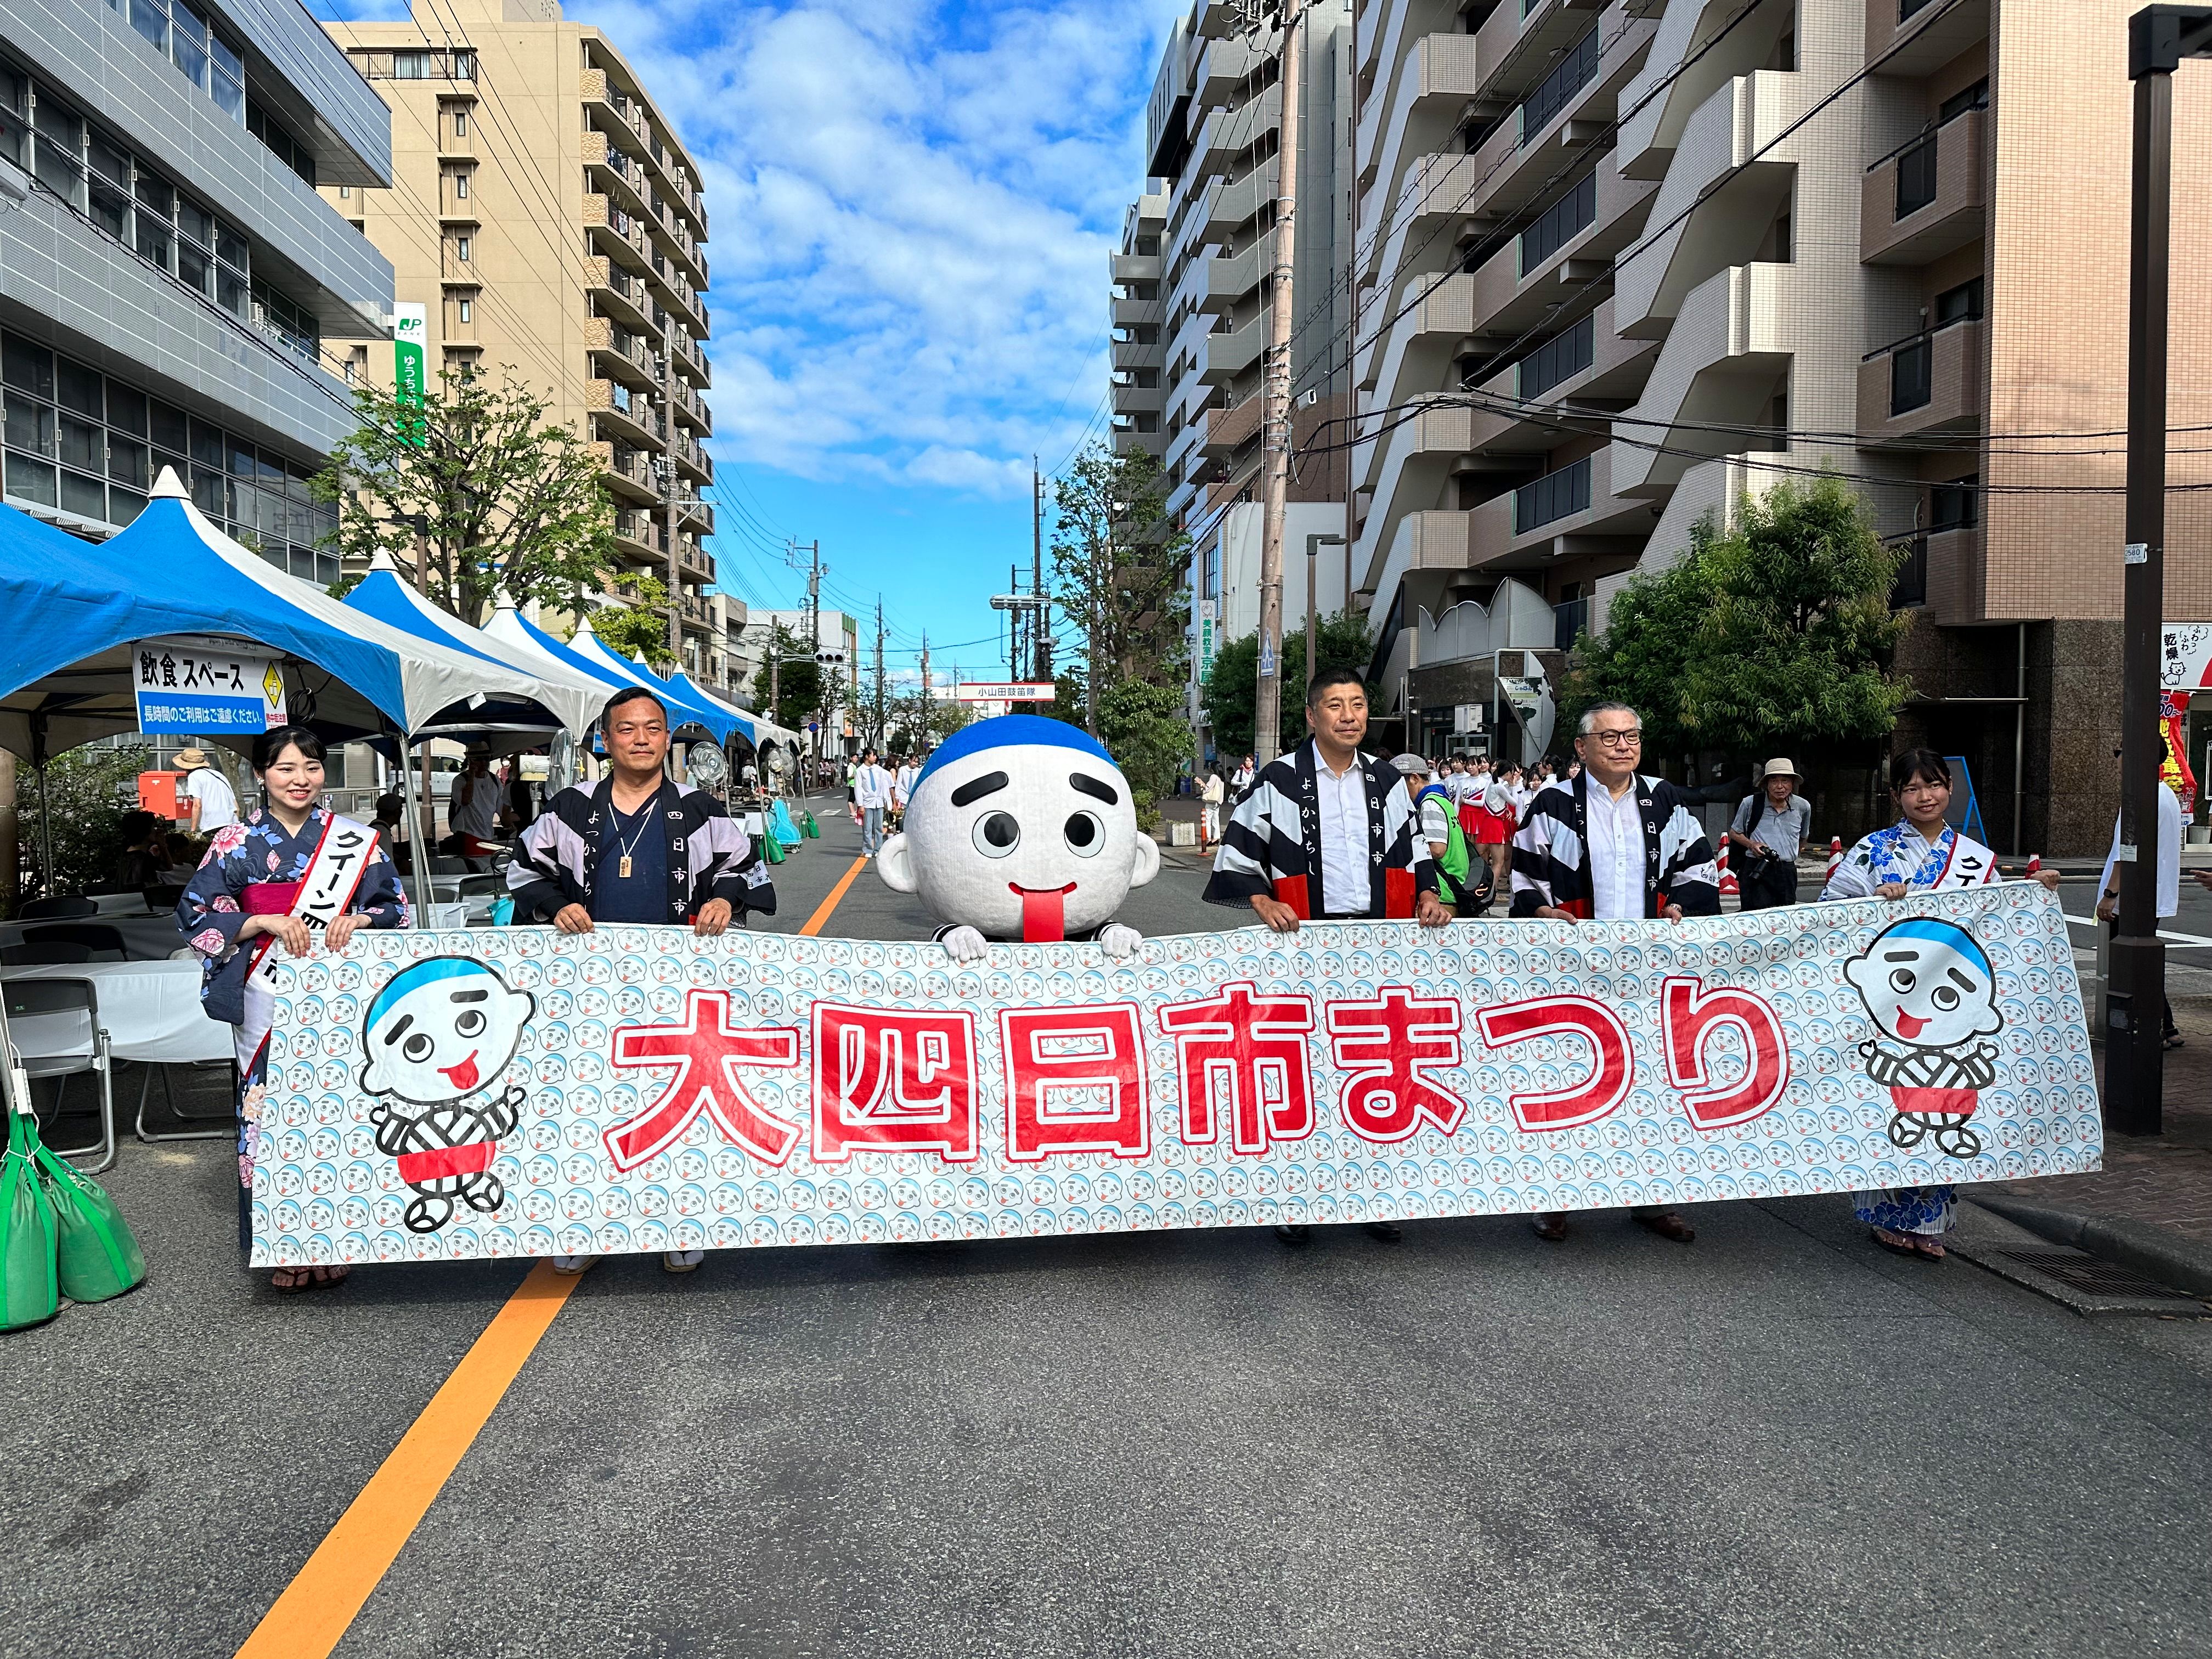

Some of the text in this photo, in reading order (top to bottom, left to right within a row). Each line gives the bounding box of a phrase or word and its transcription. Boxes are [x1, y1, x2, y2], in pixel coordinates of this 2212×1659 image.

[140, 651, 244, 691] 飲食 スペース
[144, 705, 263, 724] 長時間のご利用はご遠慮ください。
[978, 687, 1036, 697] 小山田鼓笛隊
[667, 811, 687, 916] 四日市市
[1365, 773, 1385, 867] 四日市市
[1639, 799, 1660, 891] 四日市市
[603, 976, 1790, 1173] 大四日市まつり
